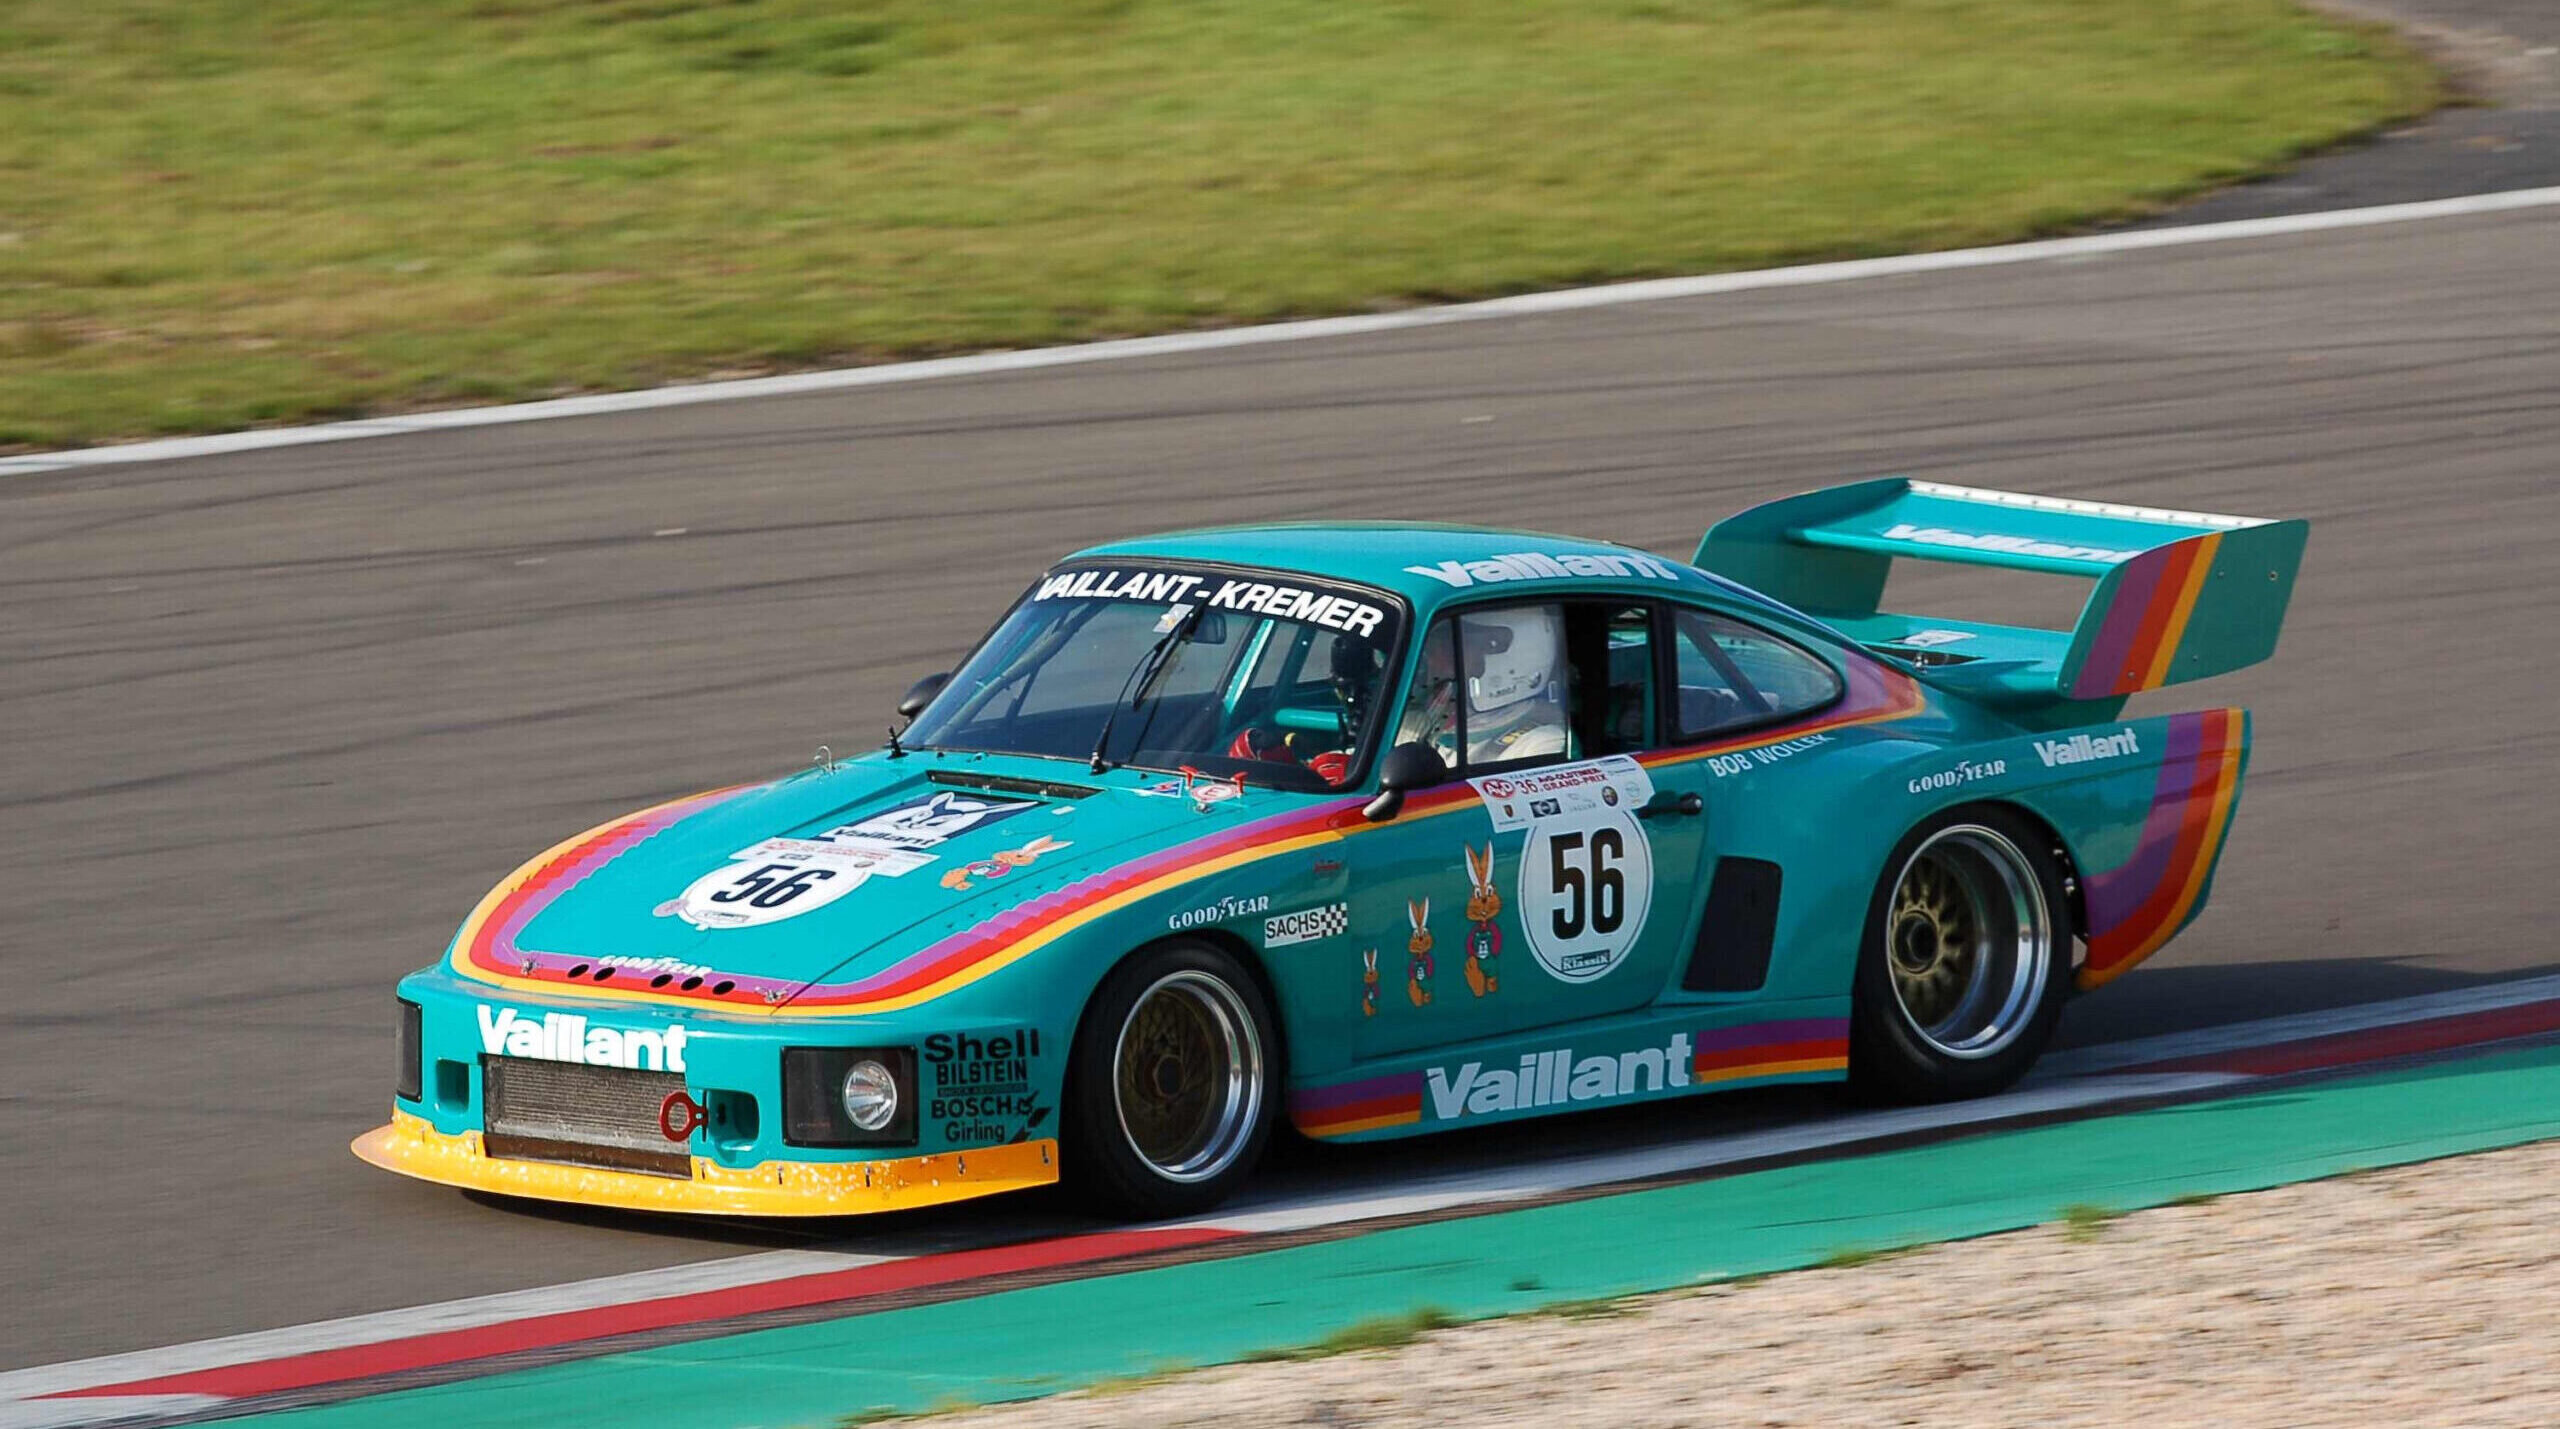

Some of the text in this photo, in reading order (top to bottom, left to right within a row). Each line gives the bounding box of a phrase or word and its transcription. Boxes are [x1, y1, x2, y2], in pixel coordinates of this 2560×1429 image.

[1403, 551, 1680, 588] Vaillant
[1707, 734, 1836, 778] BOB WOLLEK
[2033, 727, 2140, 768] Vaillant
[834, 828, 937, 846] Vaillant
[710, 864, 837, 908] 56
[1549, 827, 1625, 941] 56
[1265, 911, 1321, 940] SACHS
[1562, 953, 1609, 970] Klassik
[477, 1004, 687, 1072] Vaillant
[924, 1028, 1041, 1063] Shell
[936, 1059, 1028, 1086] BILSTEIN
[1426, 1032, 1692, 1120] Vaillant
[931, 1095, 1012, 1120] BOSCH
[945, 1119, 1005, 1143] Girling
